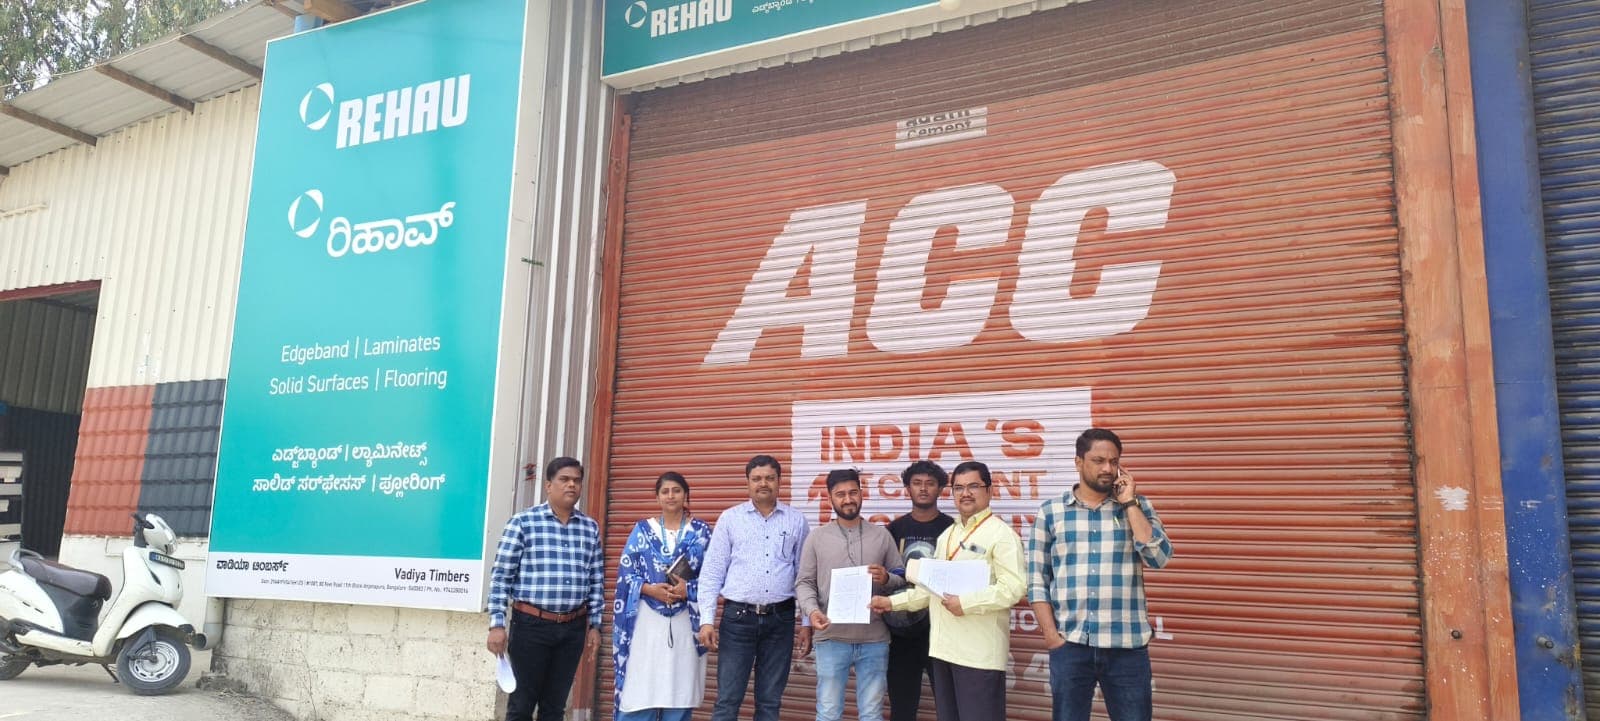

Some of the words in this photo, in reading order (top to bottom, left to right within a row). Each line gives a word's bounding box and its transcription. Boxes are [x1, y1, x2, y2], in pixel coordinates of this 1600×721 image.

[650, 0, 733, 37] REHAU
[335, 73, 471, 150] REHAU
[326, 201, 457, 258] ರಿಹಾವ್
[703, 159, 1177, 365] ACC
[281, 340, 350, 365] Edgeband
[363, 336, 441, 357] Laminates
[269, 376, 304, 395] Solid
[307, 374, 369, 393] Surfaces
[384, 367, 448, 390] Flooring
[395, 567, 426, 583] Vadiya
[429, 570, 470, 583] Timbers
